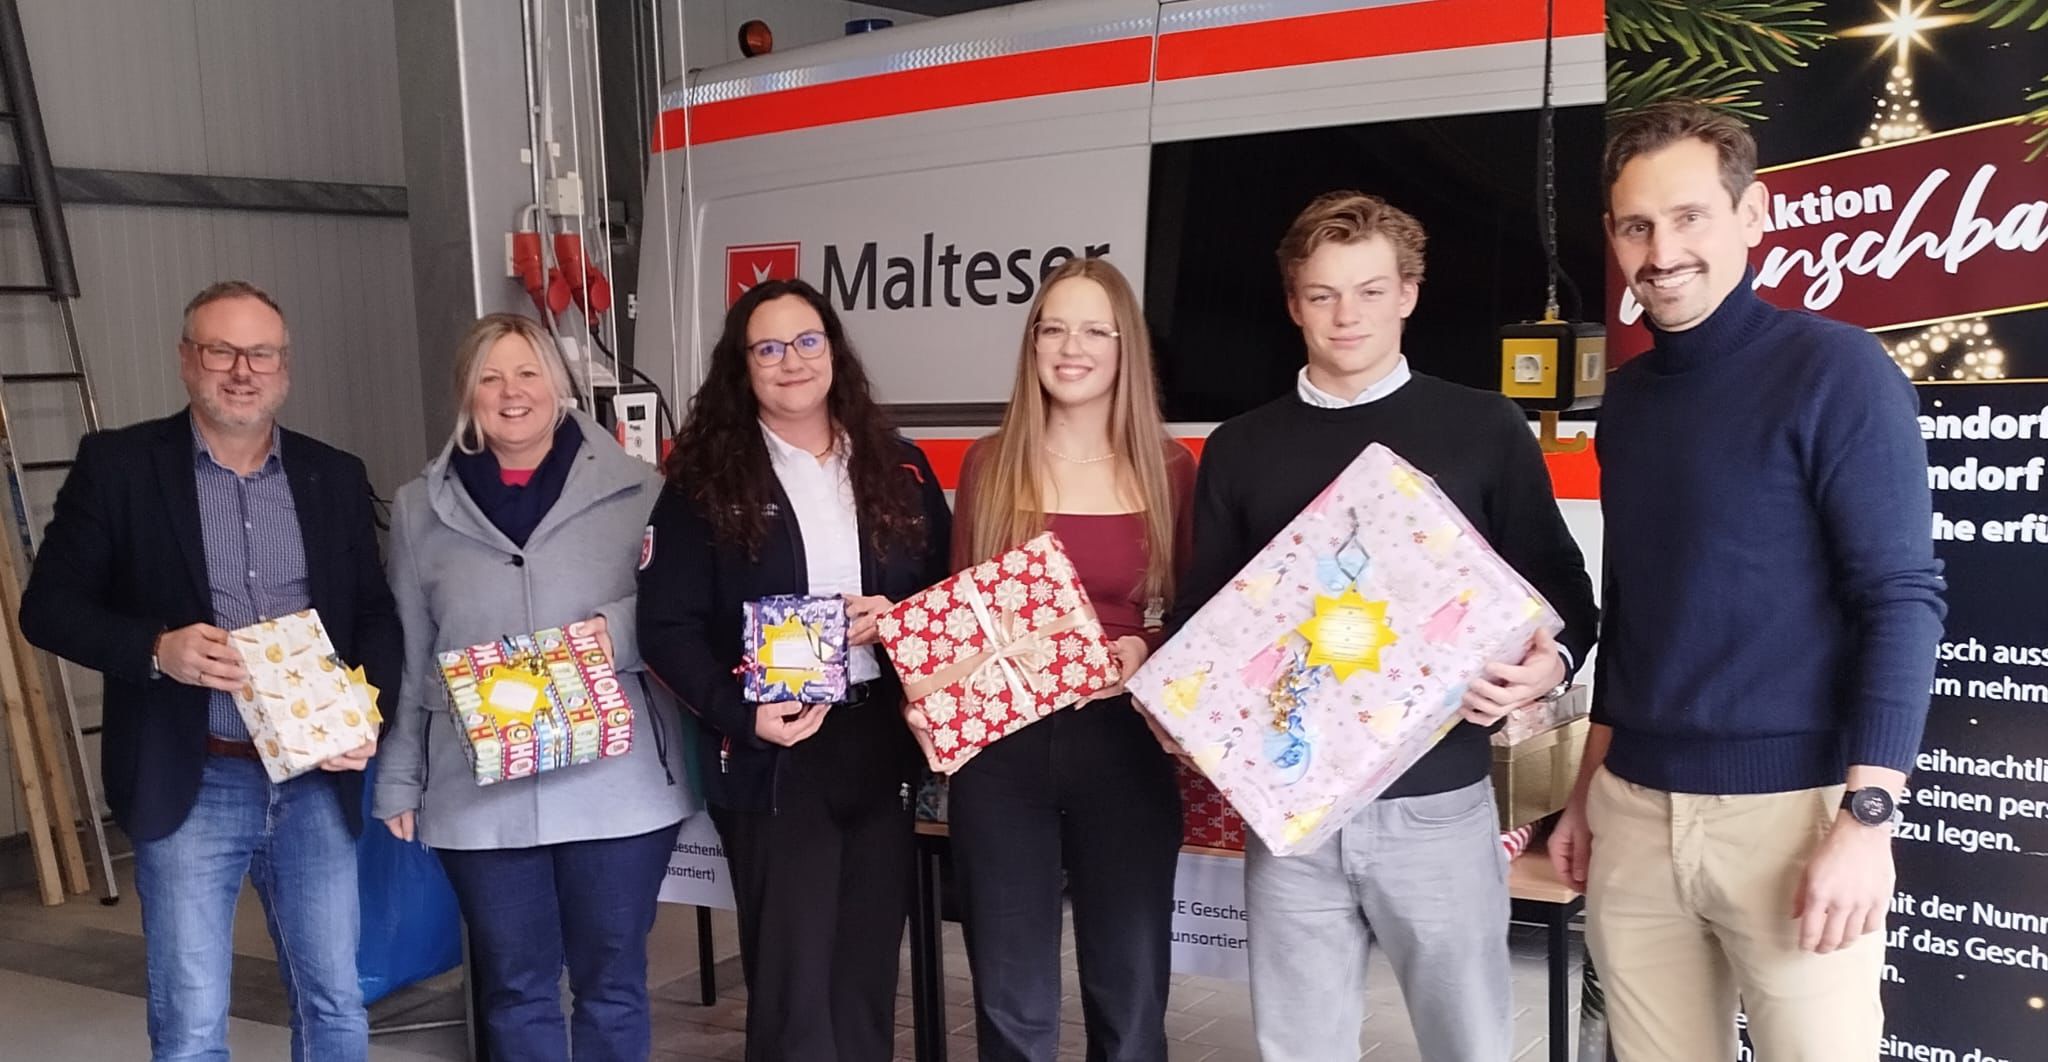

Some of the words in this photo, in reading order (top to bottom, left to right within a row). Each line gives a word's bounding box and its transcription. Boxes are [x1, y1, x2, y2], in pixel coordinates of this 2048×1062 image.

[1927, 457, 2045, 491] ndorf
[1932, 512, 1976, 541] he
[1929, 677, 1962, 697] m
[1968, 675, 2048, 704] nehm
[1916, 749, 2048, 783] eihnachtli
[1916, 784, 1992, 814] einen
[1937, 819, 2021, 853] legen.
[1920, 895, 1967, 922] der
[1912, 929, 1960, 957] das
[1965, 937, 2048, 971] Gesch
